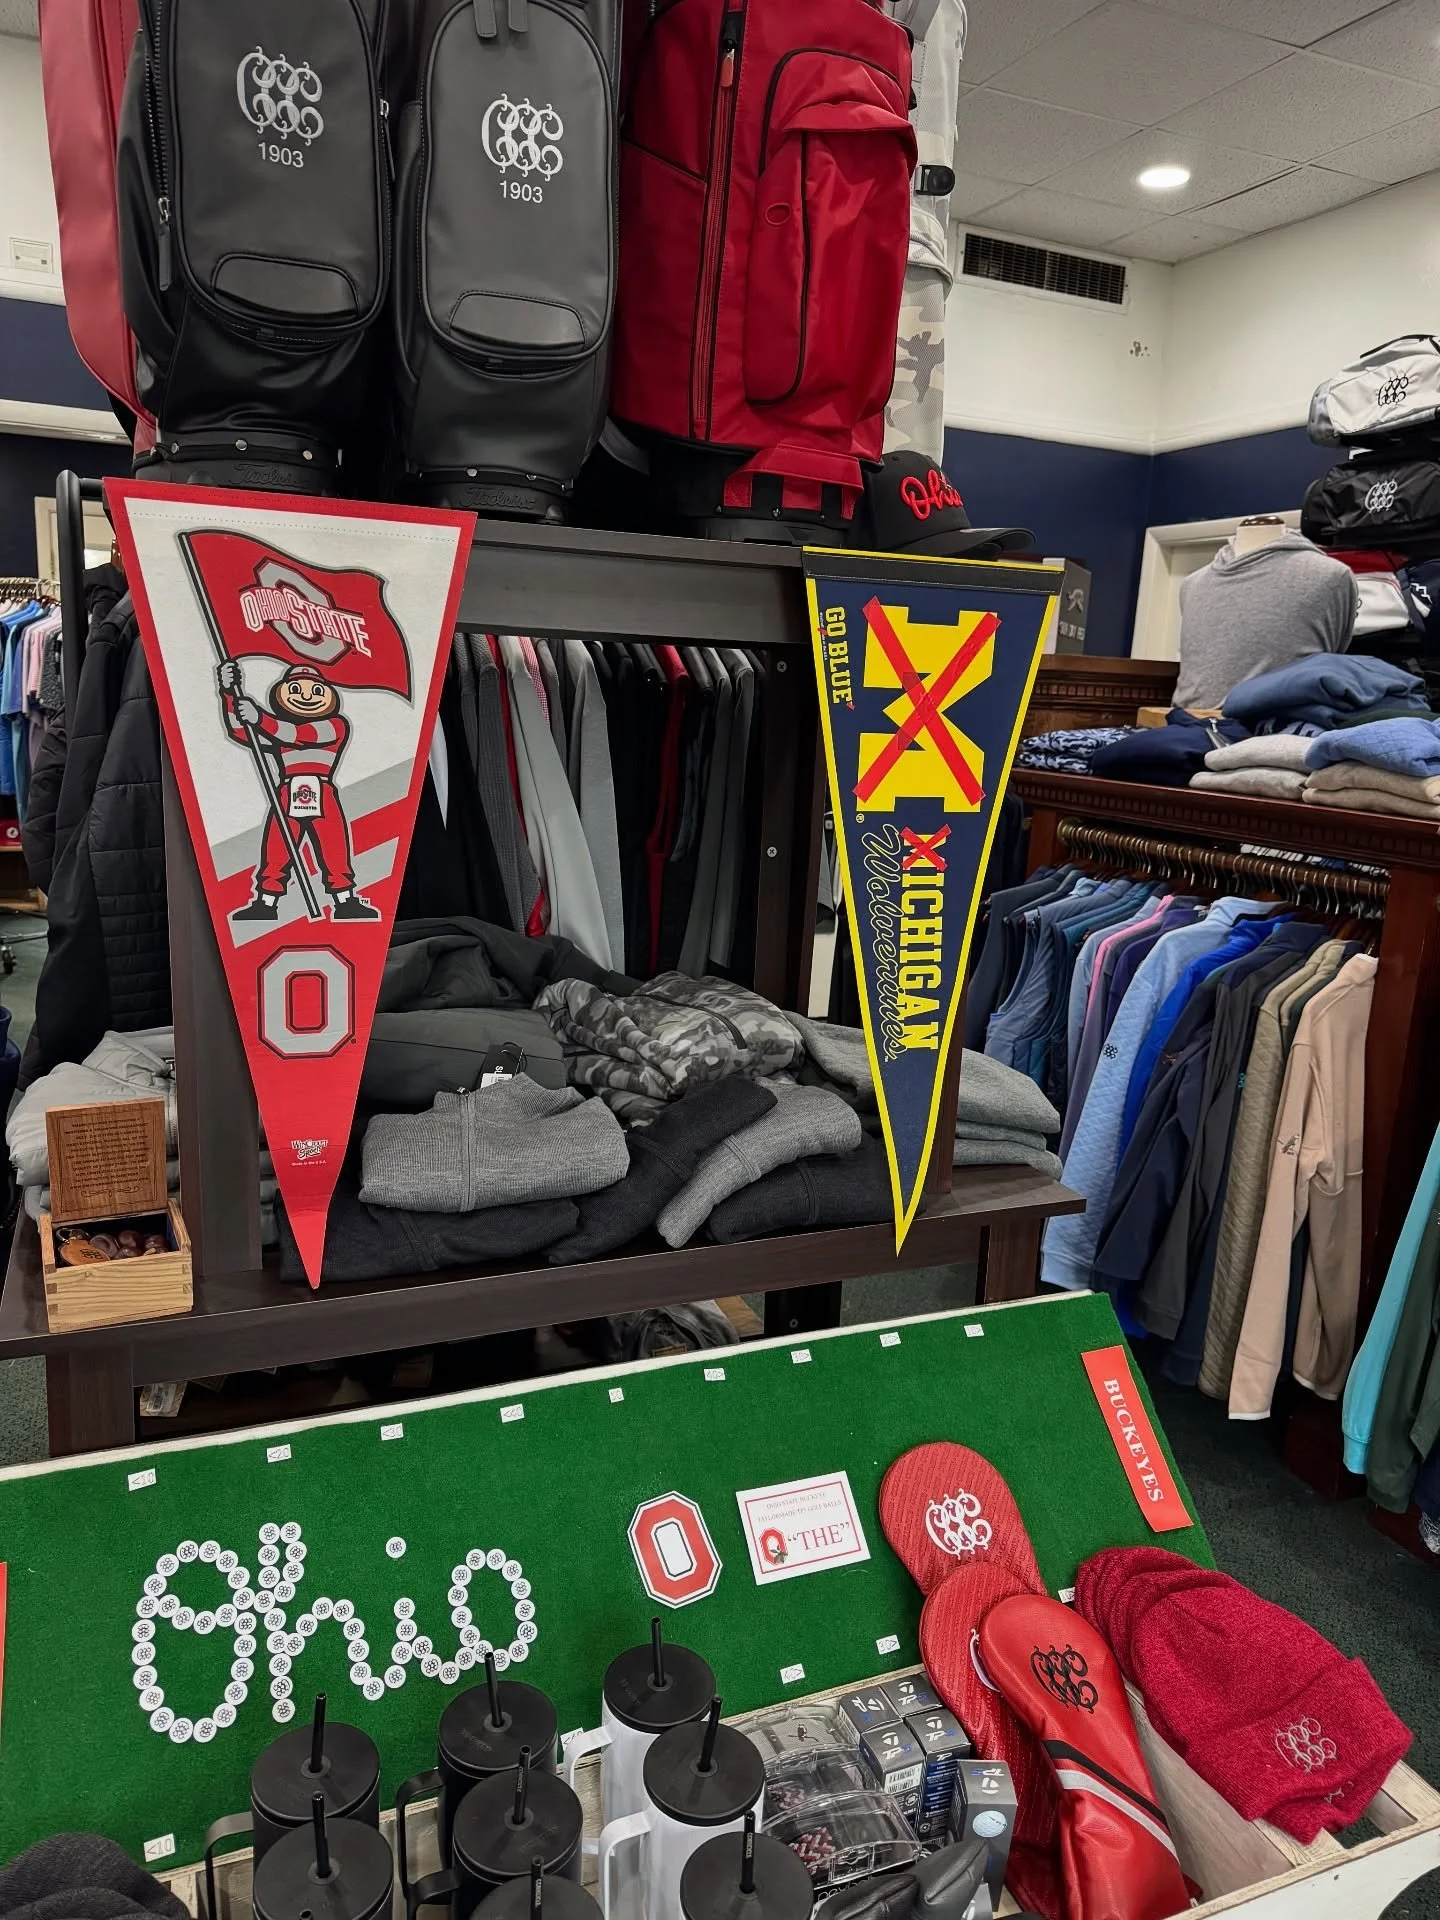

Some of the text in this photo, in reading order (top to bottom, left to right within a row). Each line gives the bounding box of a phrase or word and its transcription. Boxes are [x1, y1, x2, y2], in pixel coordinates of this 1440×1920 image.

[257, 141, 305, 169] 1903
[499, 180, 543, 204] 1903
[282, 587, 372, 658] STATE
[825, 606, 853, 704] GO BLUE
[861, 824, 908, 1060] Wolverines
[257, 944, 355, 1060] O
[1103, 1377, 1164, 1503] BUCKEYES
[628, 1491, 723, 1609] O
[131, 1521, 537, 1744] Ohio
[146, 1838, 172, 1855] <10
